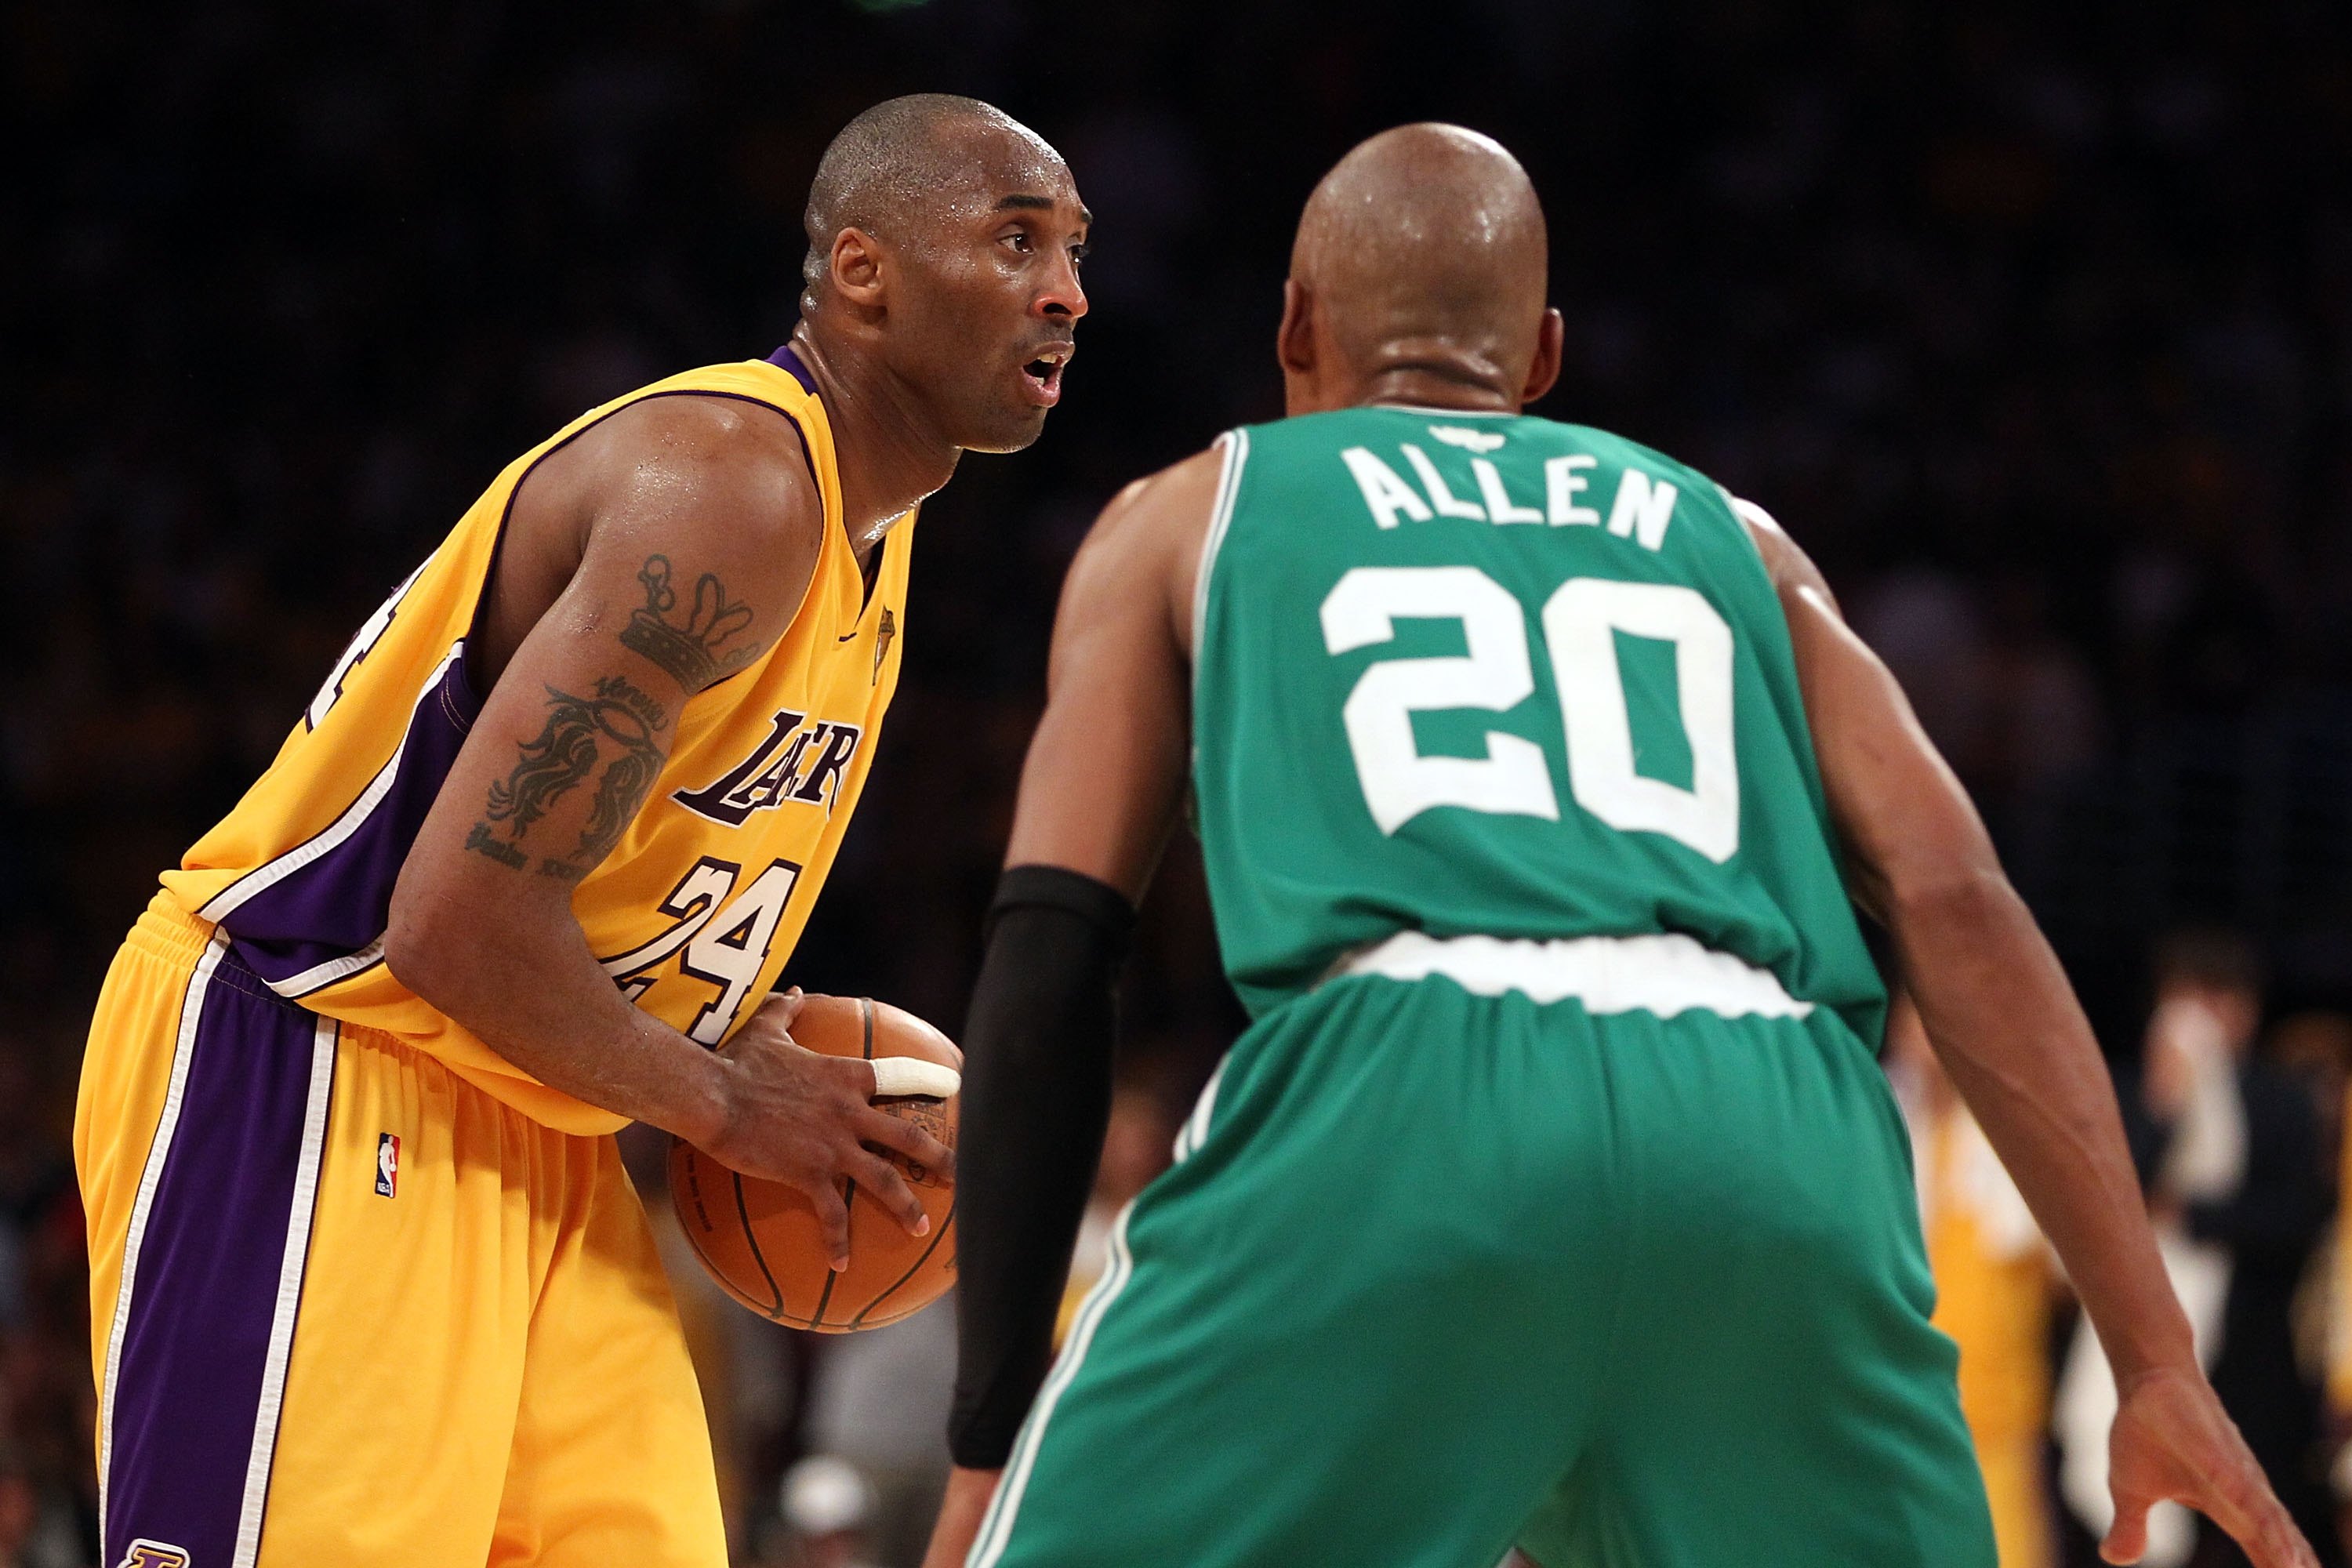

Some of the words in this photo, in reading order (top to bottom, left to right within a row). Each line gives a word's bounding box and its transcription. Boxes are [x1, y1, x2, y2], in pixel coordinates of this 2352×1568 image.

[1341, 444, 1678, 551] ALLEN
[666, 707, 865, 829] LAR
[1319, 565, 1740, 865] 20
[597, 855, 803, 1051] 24
